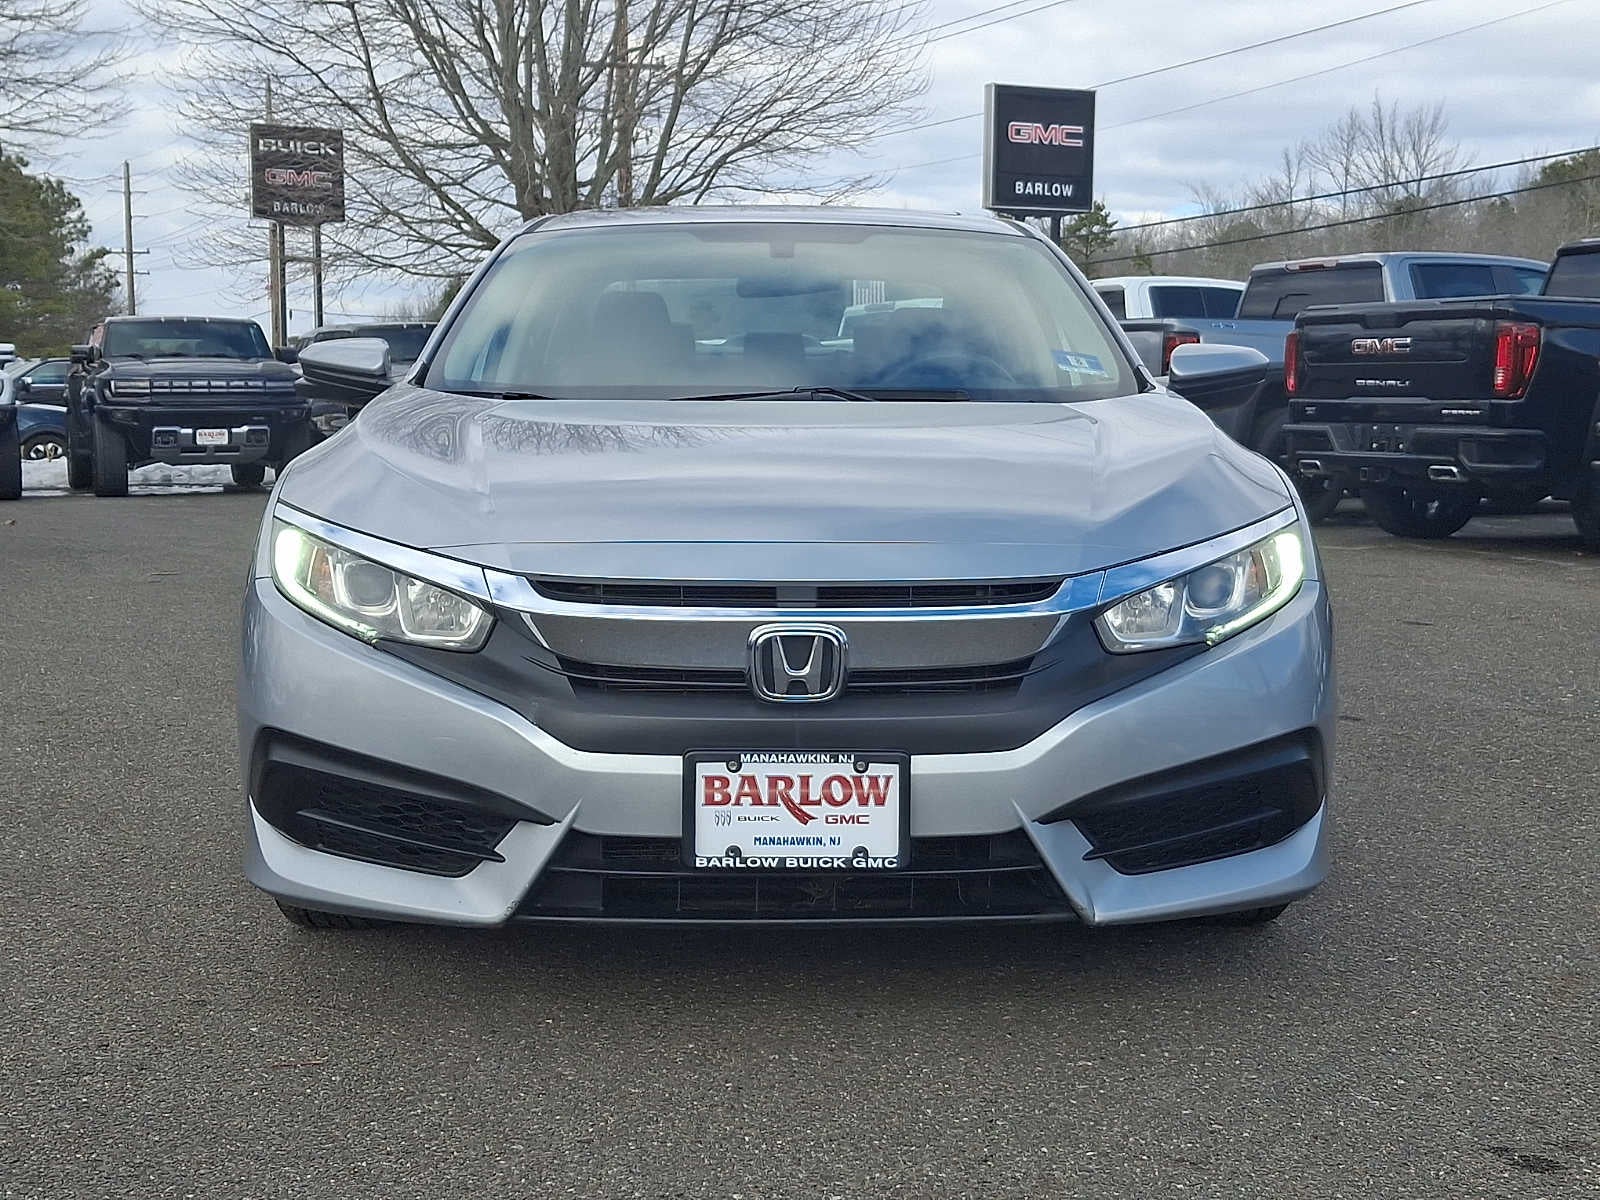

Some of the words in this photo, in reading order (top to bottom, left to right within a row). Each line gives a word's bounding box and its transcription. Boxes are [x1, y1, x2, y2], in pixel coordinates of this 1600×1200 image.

[1008, 121, 1083, 147] GMC
[257, 138, 337, 155] BUICK
[264, 168, 333, 188] GMC
[1015, 181, 1073, 197] BARLOW
[1351, 337, 1412, 354] GMC
[838, 753, 855, 763] NJ
[701, 774, 894, 826] BARLOW
[825, 814, 870, 825] GMC
[753, 836, 827, 847] MANAHAWKIN,
[829, 837, 841, 846] NJ
[695, 857, 779, 868] BARLOW
[785, 857, 846, 868] BUICK
[852, 857, 898, 868] GMC
